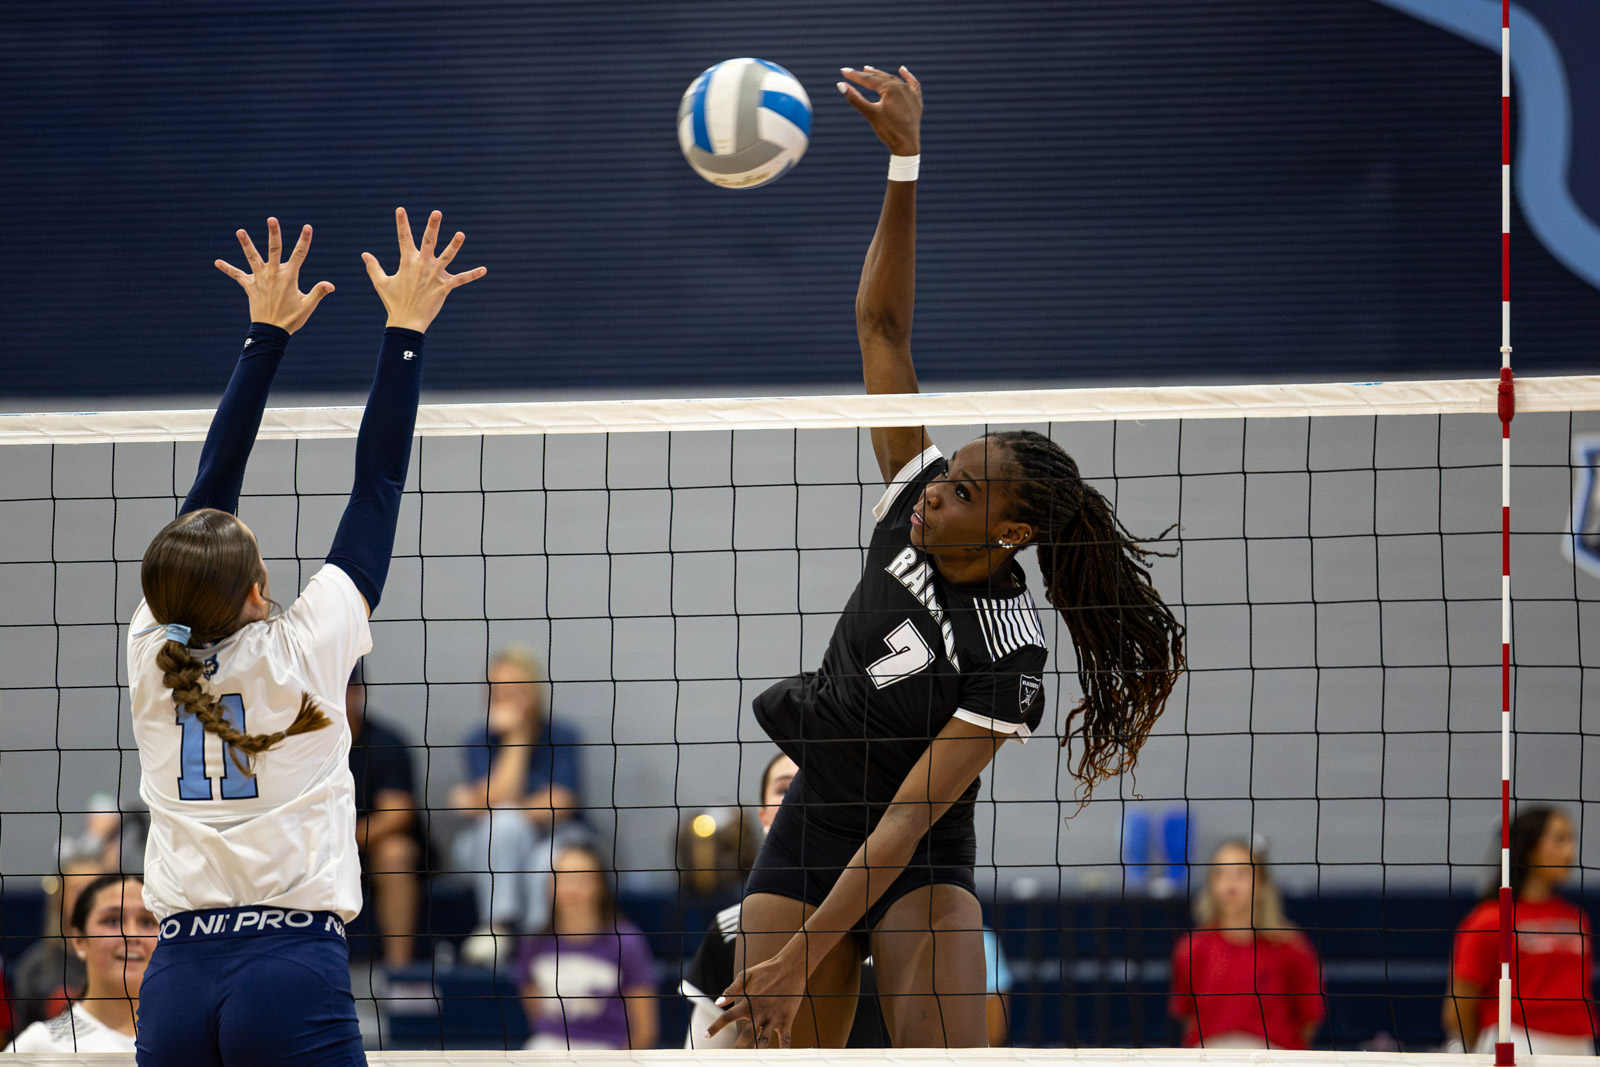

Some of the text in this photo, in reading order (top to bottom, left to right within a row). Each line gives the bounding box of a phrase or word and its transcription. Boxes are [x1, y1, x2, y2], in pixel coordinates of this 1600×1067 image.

[865, 618, 936, 690] 7
[175, 692, 259, 800] 11
[233, 909, 314, 933] PRO
